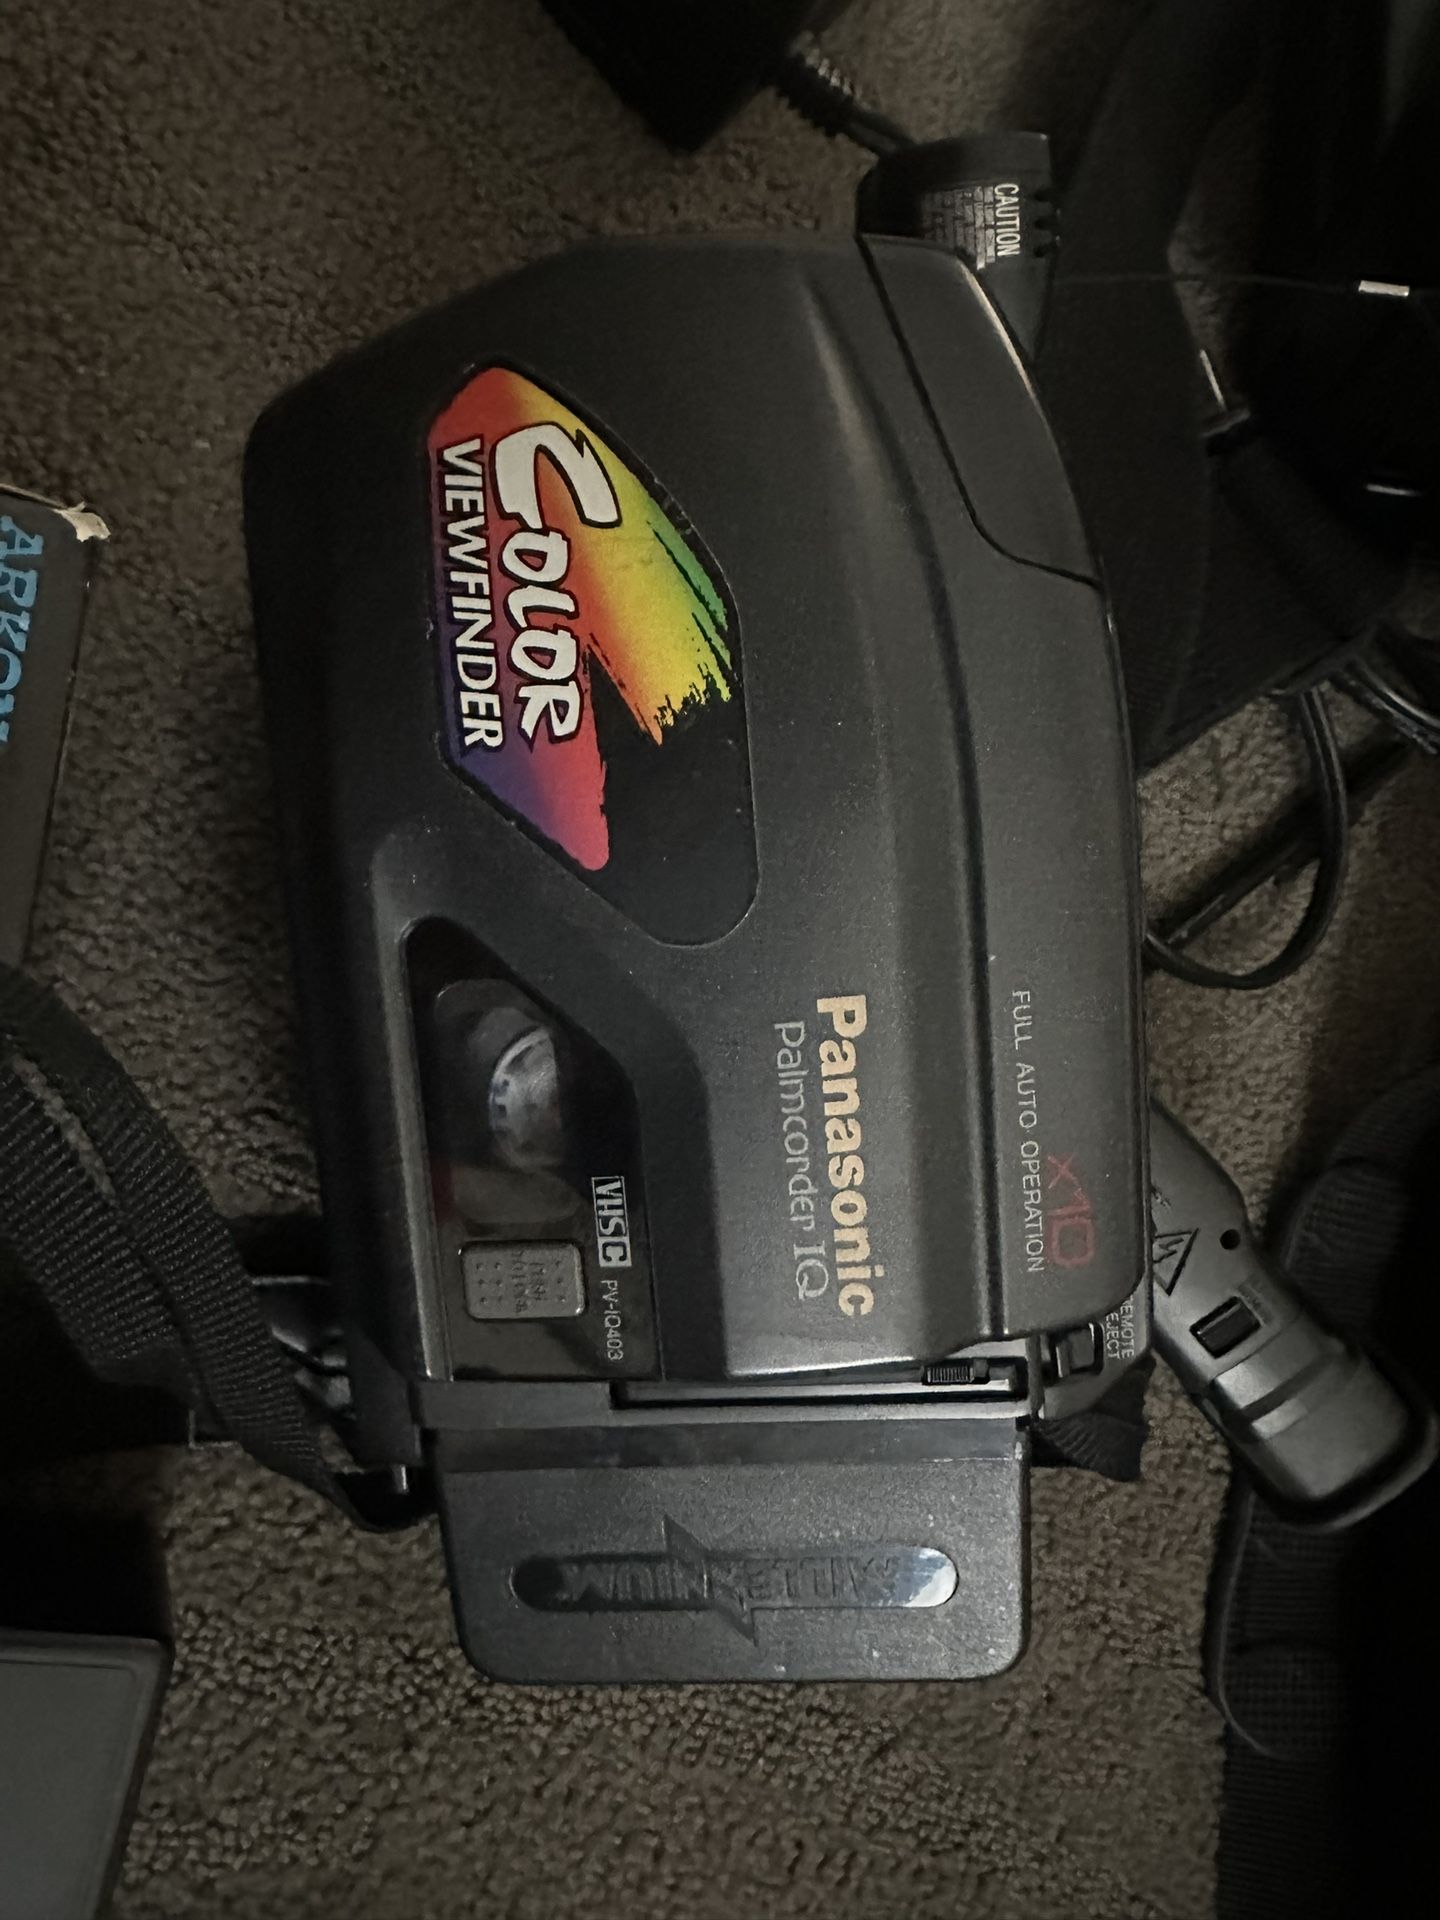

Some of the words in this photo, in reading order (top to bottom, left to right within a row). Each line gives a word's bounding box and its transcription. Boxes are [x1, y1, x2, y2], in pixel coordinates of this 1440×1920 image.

[994, 183, 1021, 257] CAUTION
[442, 437, 504, 748] VIEWFINDER
[492, 422, 622, 748] COLOR
[1012, 990, 1032, 1050] FULL
[774, 1020, 820, 1230] Palmcorder
[1016, 1062, 1038, 1129] AUTO
[816, 994, 884, 1316] Panasonic
[1020, 1140, 1045, 1272] OPERATION
[793, 1239, 830, 1302] IQ
[600, 1279, 624, 1361] PV-IQ403
[1105, 1312, 1120, 1360] EJECT
